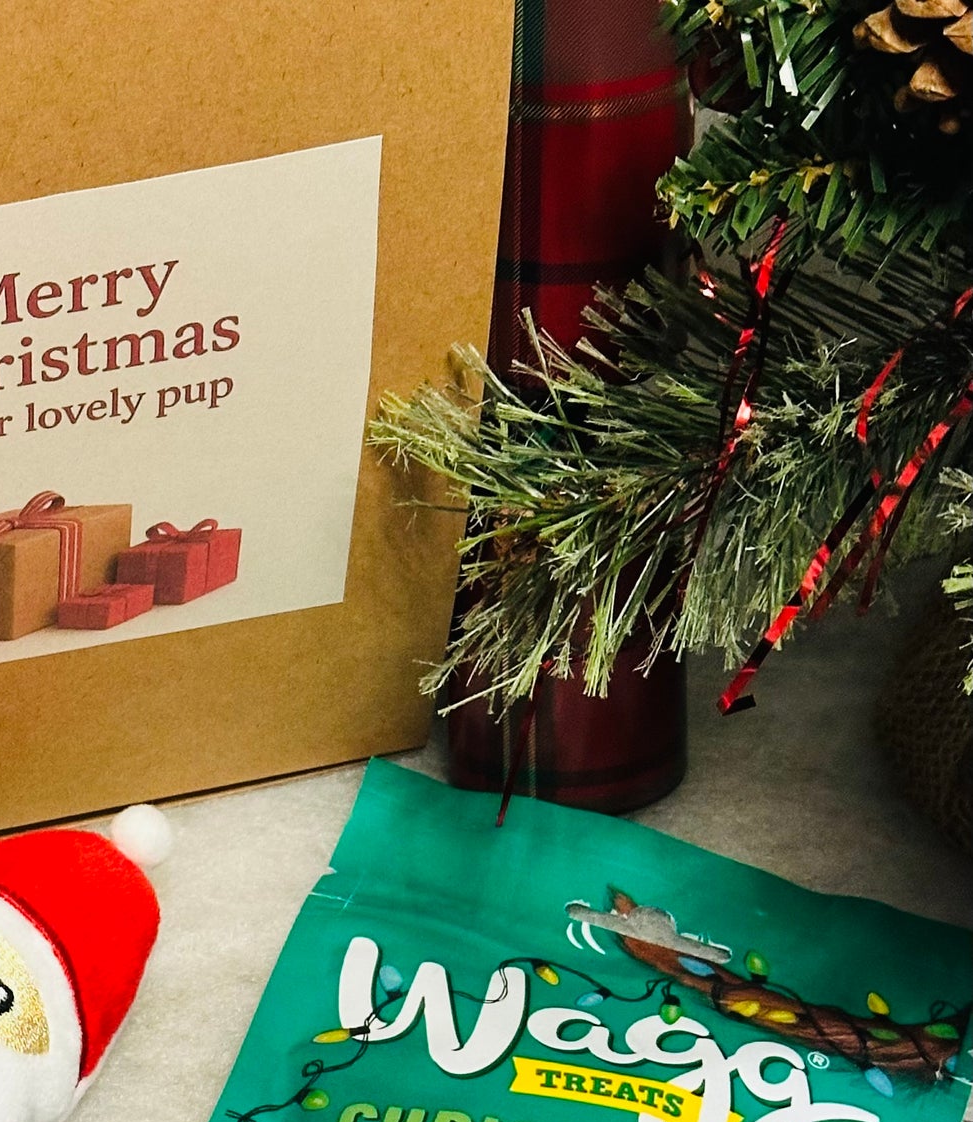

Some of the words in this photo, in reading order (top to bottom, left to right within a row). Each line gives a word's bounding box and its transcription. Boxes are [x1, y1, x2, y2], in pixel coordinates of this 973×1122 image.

[25, 388, 146, 432] lovely
[156, 376, 235, 418] pup
[535, 1068, 686, 1118] TREATS
